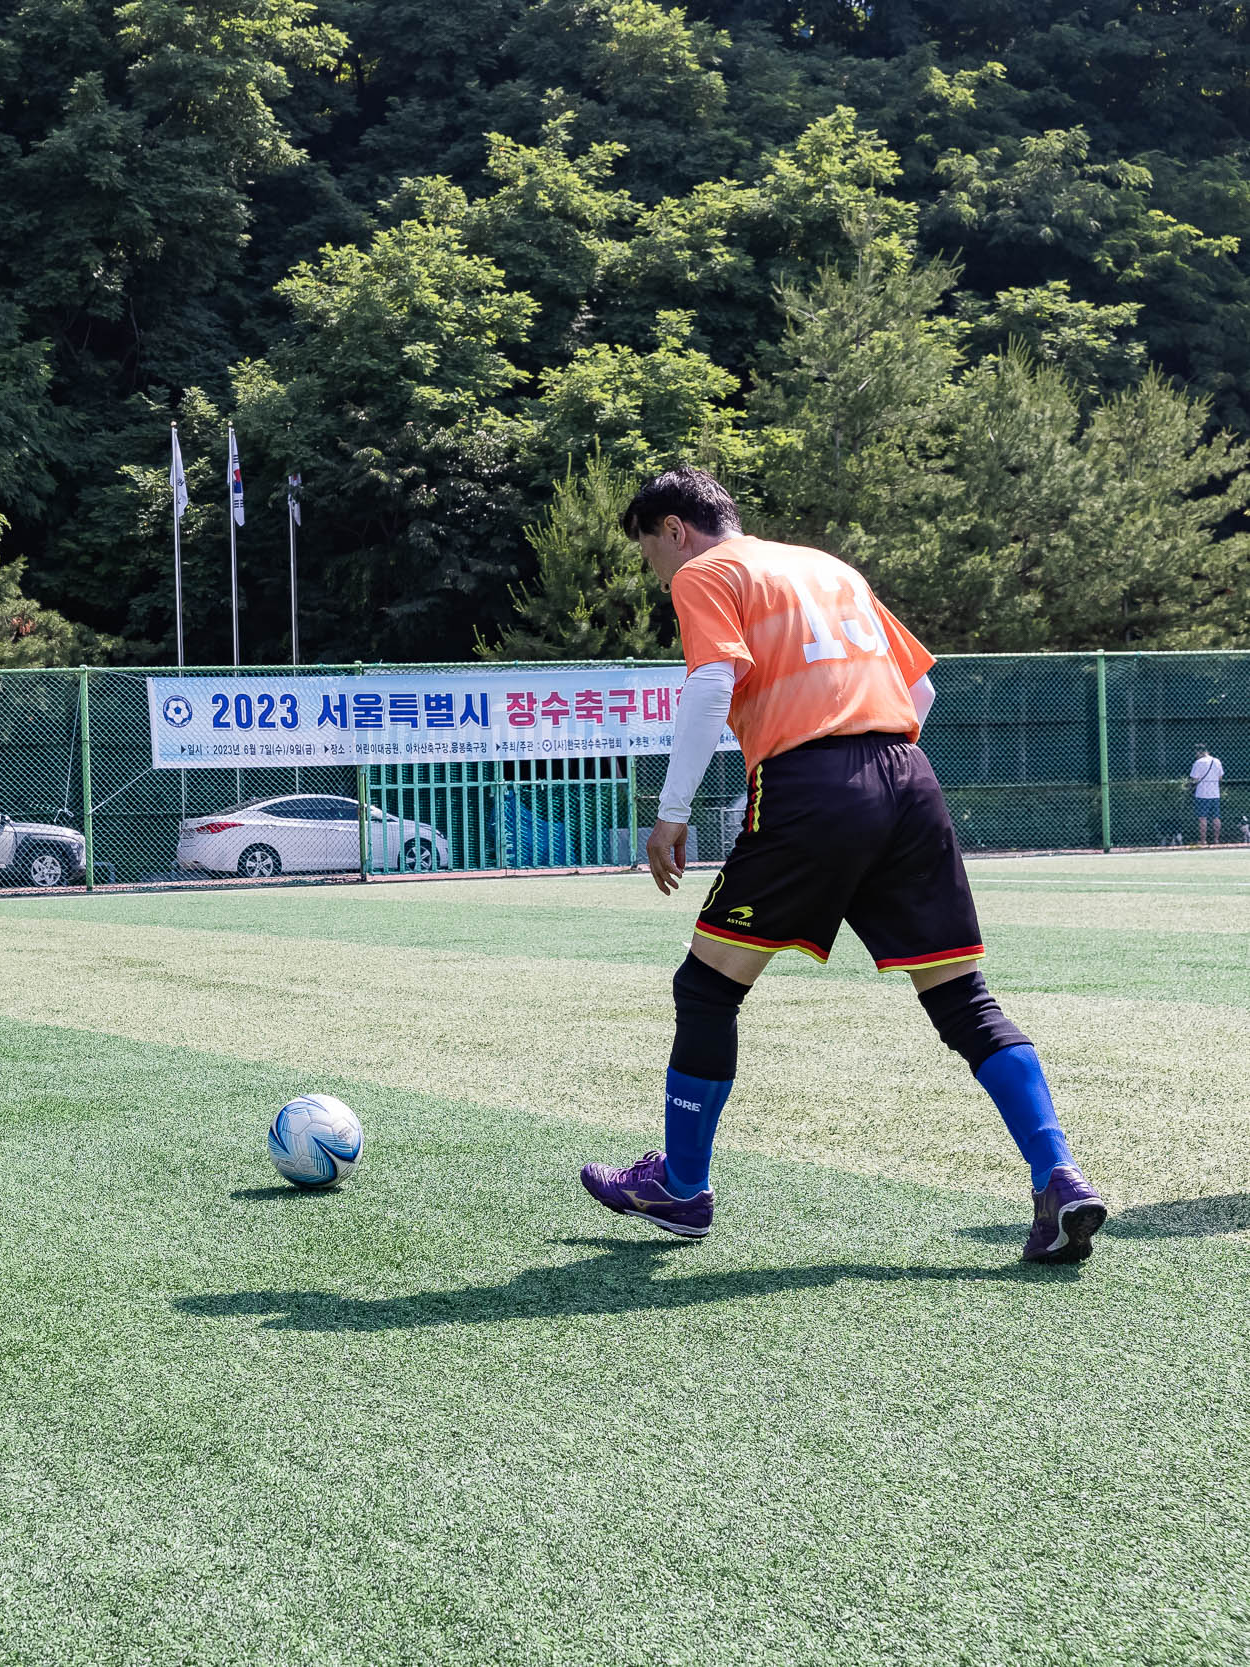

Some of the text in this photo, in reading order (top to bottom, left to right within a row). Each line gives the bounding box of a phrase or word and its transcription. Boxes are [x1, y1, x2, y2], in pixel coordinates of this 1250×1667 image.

[768, 562, 889, 663] 13
[211, 693, 300, 731] 2023
[318, 691, 490, 731] 서울특별시
[187, 744, 203, 756] 일시
[213, 744, 240, 756] 2023년
[244, 744, 257, 757] 6월
[259, 743, 316, 757] 7일(수)/9일(금)
[330, 743, 346, 756] 장소
[501, 740, 535, 755] 주최/주관
[635, 736, 649, 748] 후원
[659, 735, 675, 747] 서울
[726, 917, 752, 929] ASTORE
